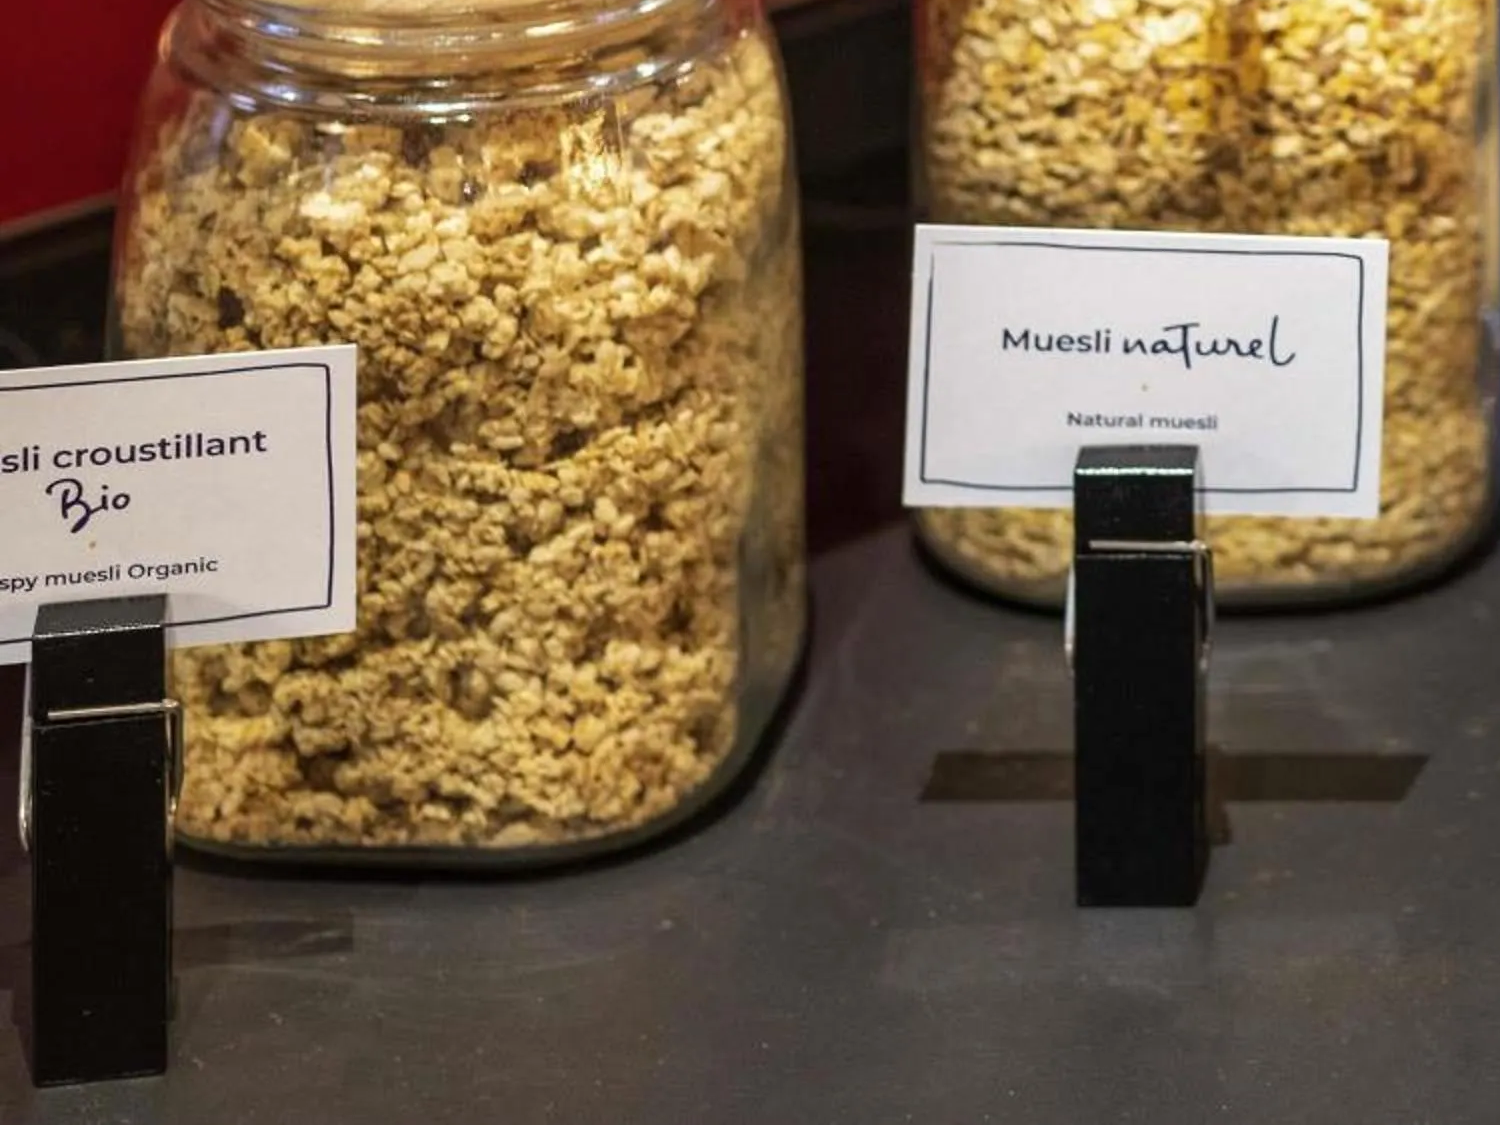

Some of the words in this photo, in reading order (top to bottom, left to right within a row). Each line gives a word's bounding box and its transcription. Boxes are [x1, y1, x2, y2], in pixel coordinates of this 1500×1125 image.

[1001, 327, 1111, 354] Muesli
[1121, 314, 1297, 370] naturel
[1066, 410, 1145, 430] Natural
[1149, 413, 1219, 431] muesli
[1, 445, 40, 473] sli
[52, 429, 268, 469] croustillant
[45, 477, 131, 534] Bio
[44, 564, 121, 587] muesli
[127, 556, 219, 581] Organic
